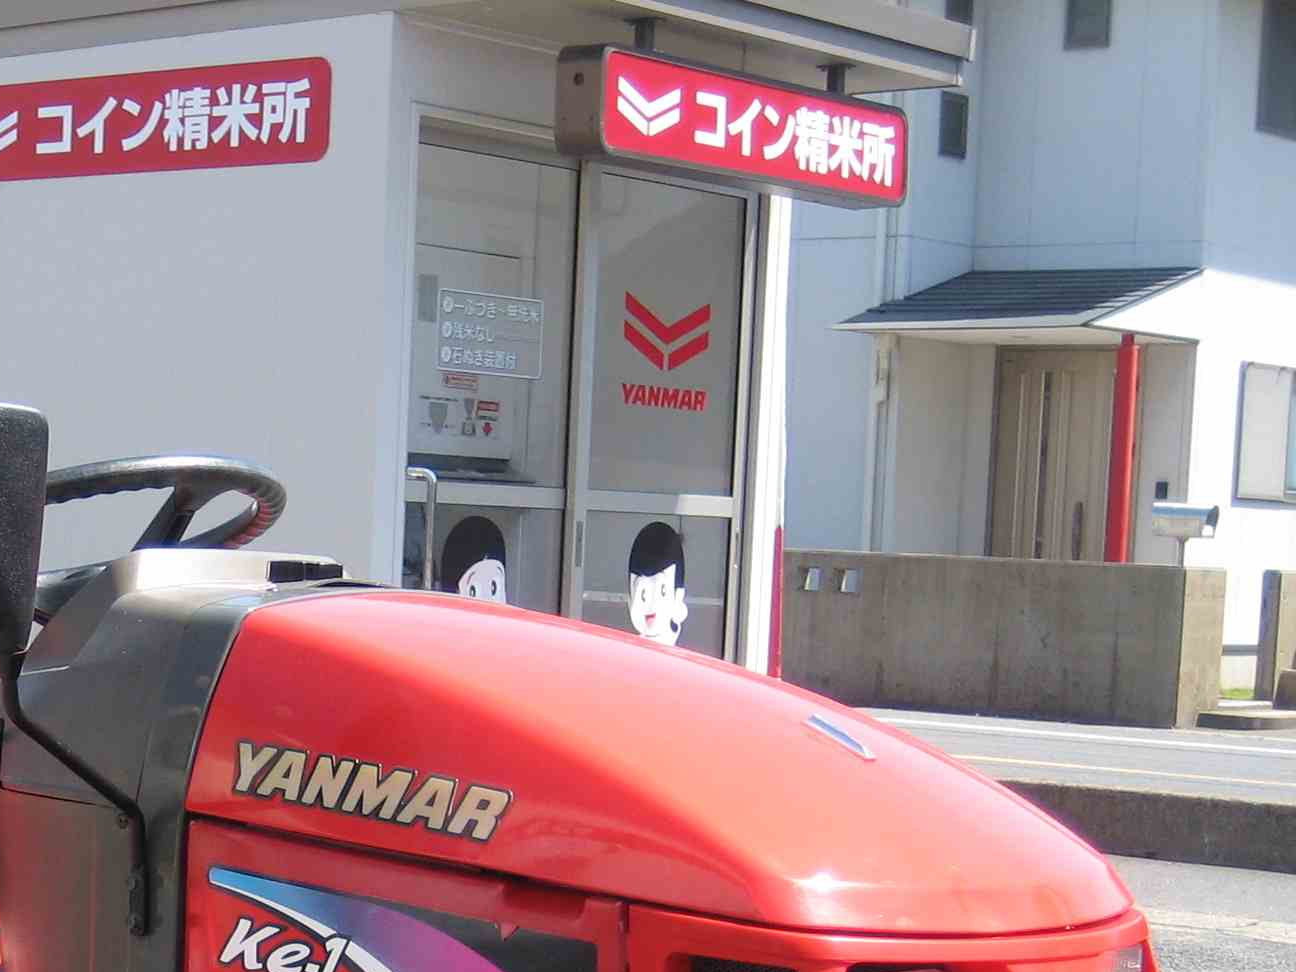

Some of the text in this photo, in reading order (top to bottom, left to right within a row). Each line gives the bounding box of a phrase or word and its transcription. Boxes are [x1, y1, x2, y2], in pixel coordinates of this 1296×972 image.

[35, 77, 311, 155] コイン精米所
[693, 91, 897, 187] コイン精米所
[621, 382, 707, 412] YANMAR
[233, 742, 513, 841] YANMAR
